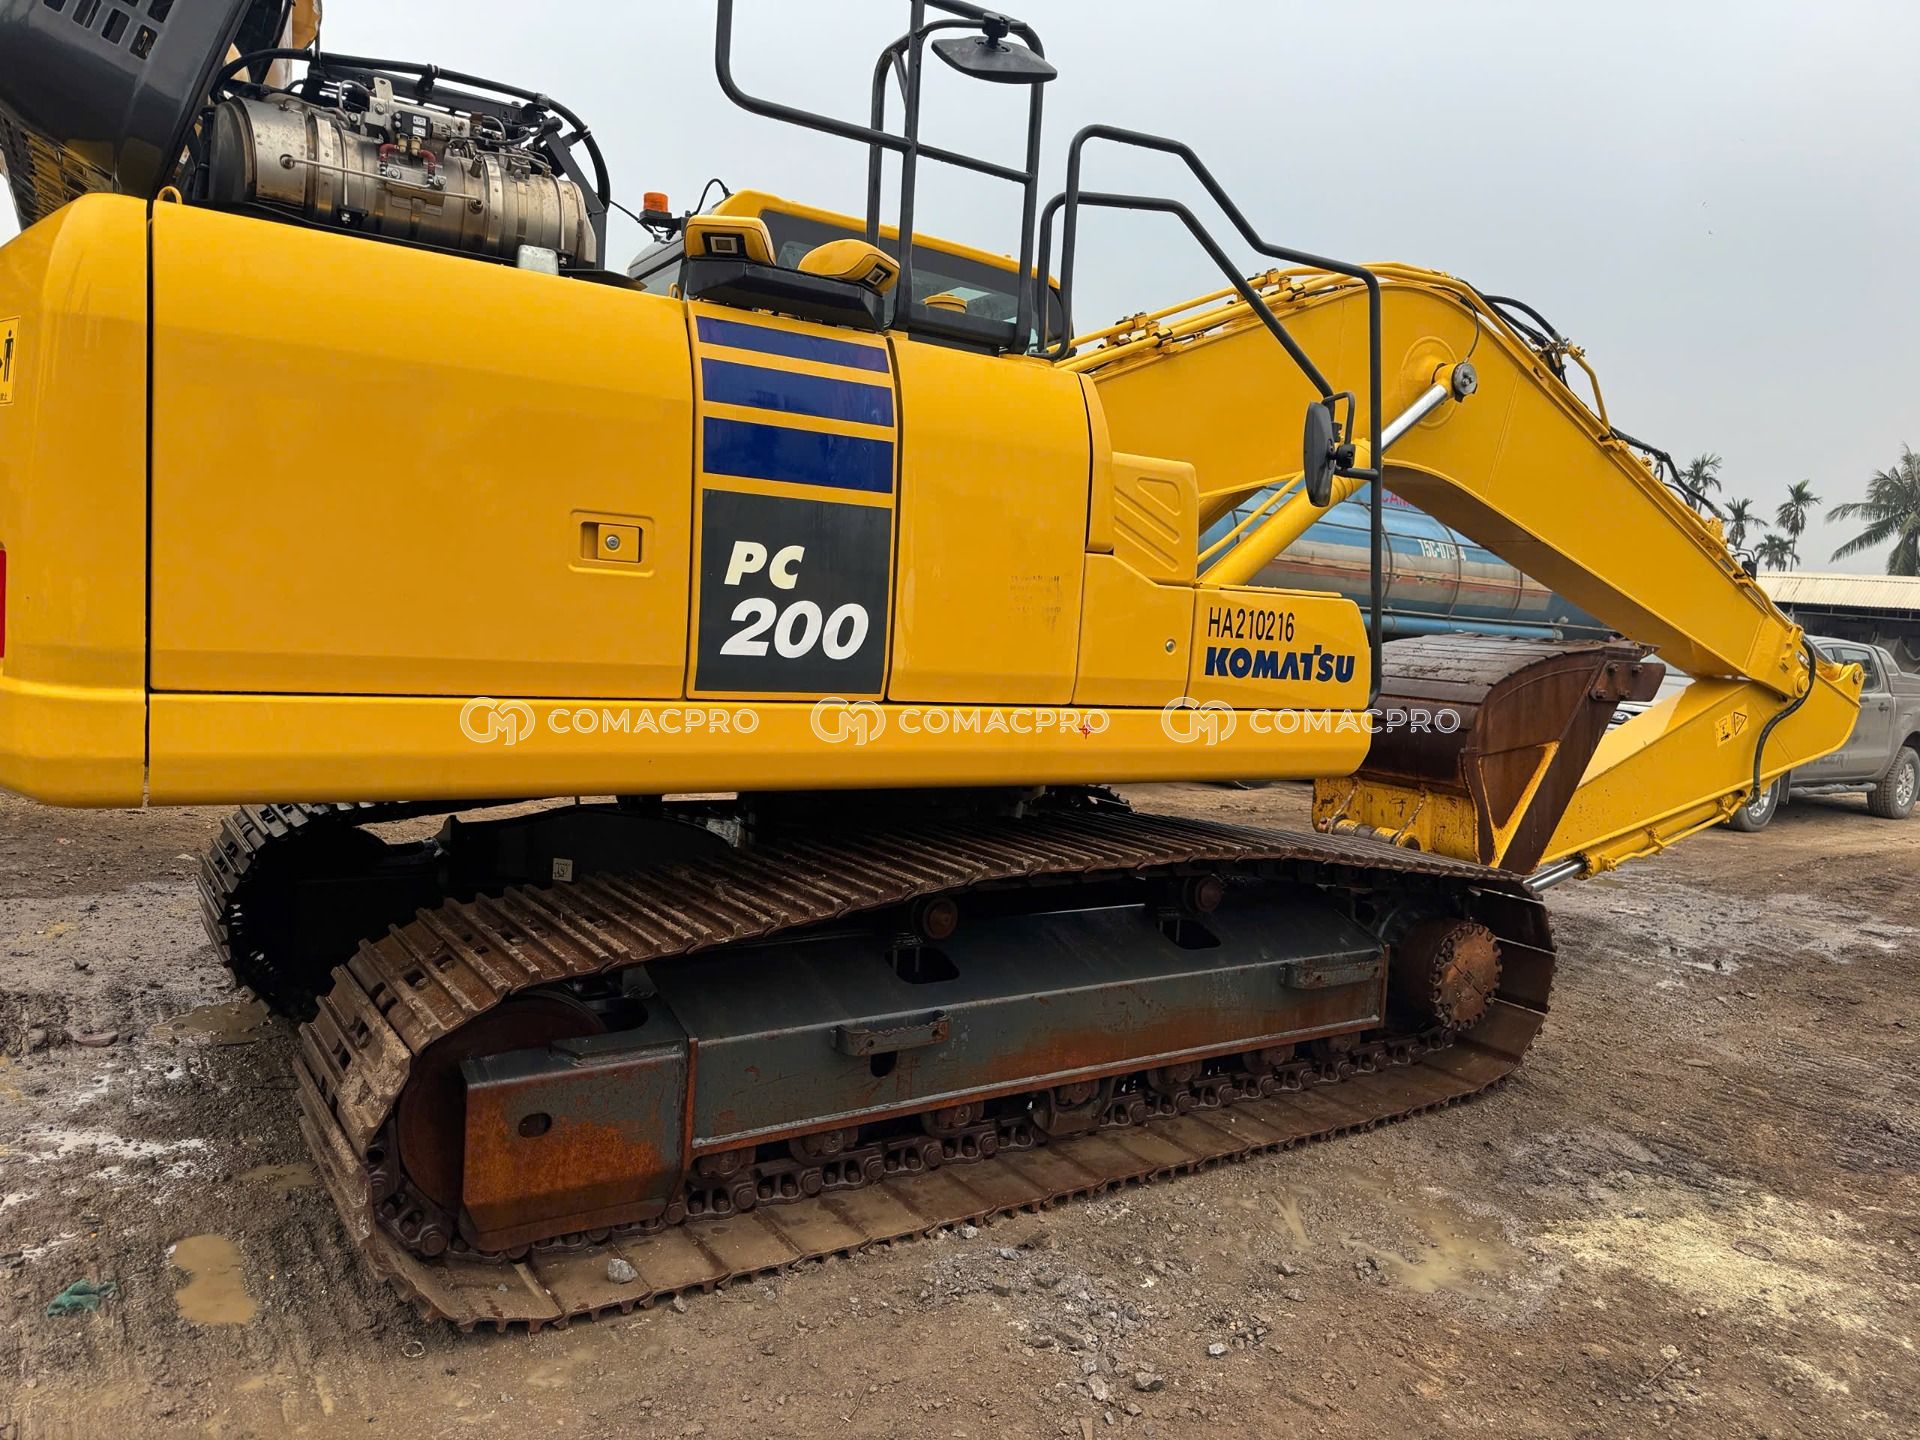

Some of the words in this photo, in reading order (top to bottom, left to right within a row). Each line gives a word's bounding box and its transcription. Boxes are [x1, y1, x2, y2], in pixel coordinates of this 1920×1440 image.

[724, 540, 805, 590] PC
[719, 597, 869, 660] 200
[1208, 606, 1295, 642] HA210216
[1204, 644, 1355, 683] KOMATSU
